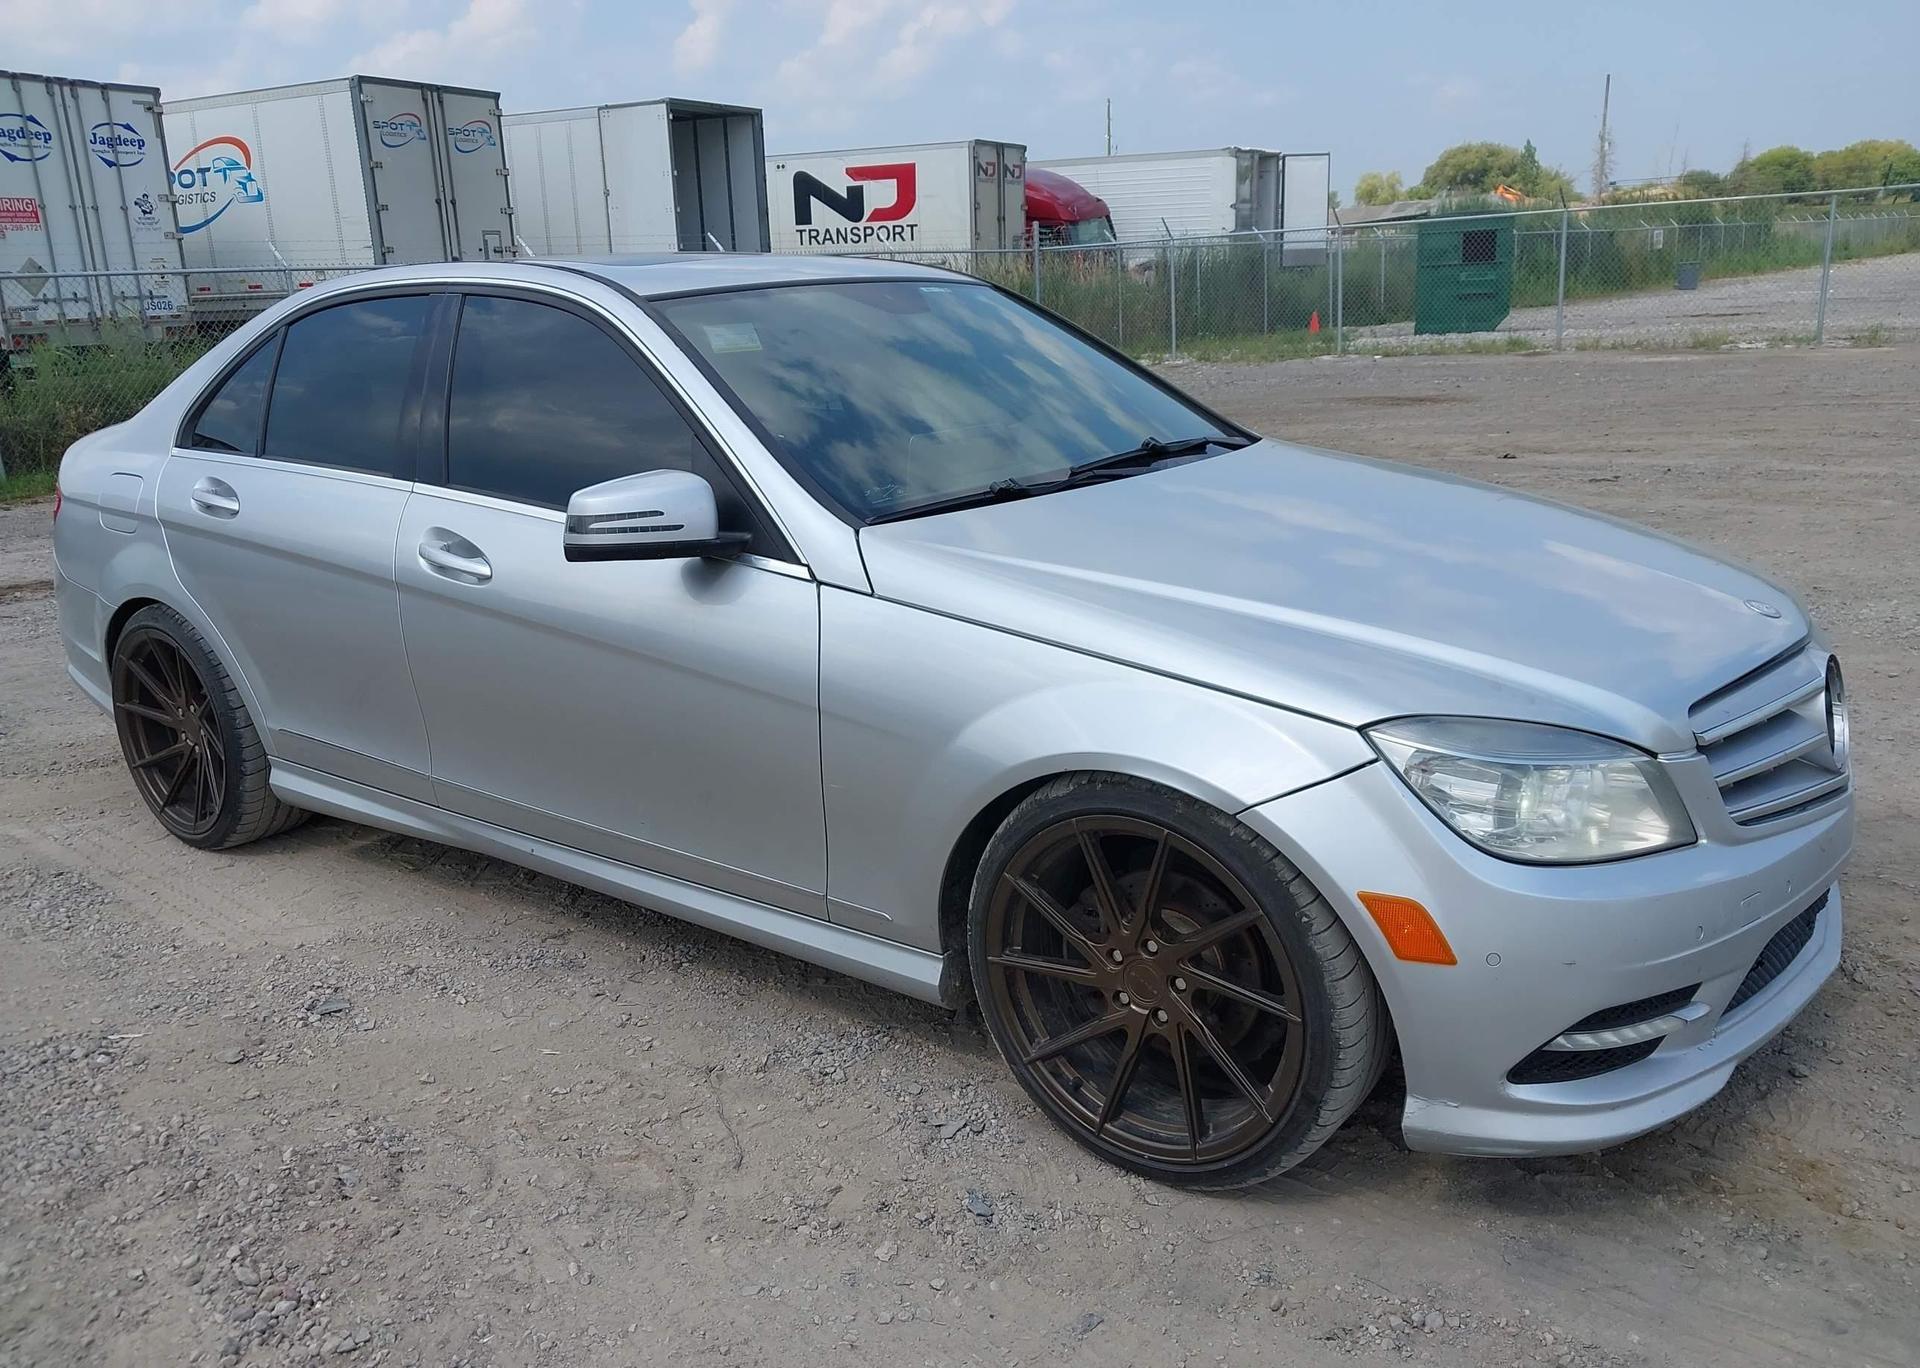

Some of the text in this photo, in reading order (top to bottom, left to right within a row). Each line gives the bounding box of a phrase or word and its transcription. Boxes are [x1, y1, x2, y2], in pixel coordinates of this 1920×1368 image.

[372, 120, 405, 131] SPOT
[447, 127, 477, 137] SPOT
[0, 126, 52, 144] agdeep
[90, 132, 146, 150] Jagdeep
[170, 167, 211, 189] OT
[177, 191, 216, 205] GISTICS
[793, 162, 916, 226] NJ
[0, 198, 37, 212] IRING!
[0, 224, 43, 232] 04-298-1721
[795, 223, 918, 246] TRANSPORT
[145, 301, 173, 311] JS026
